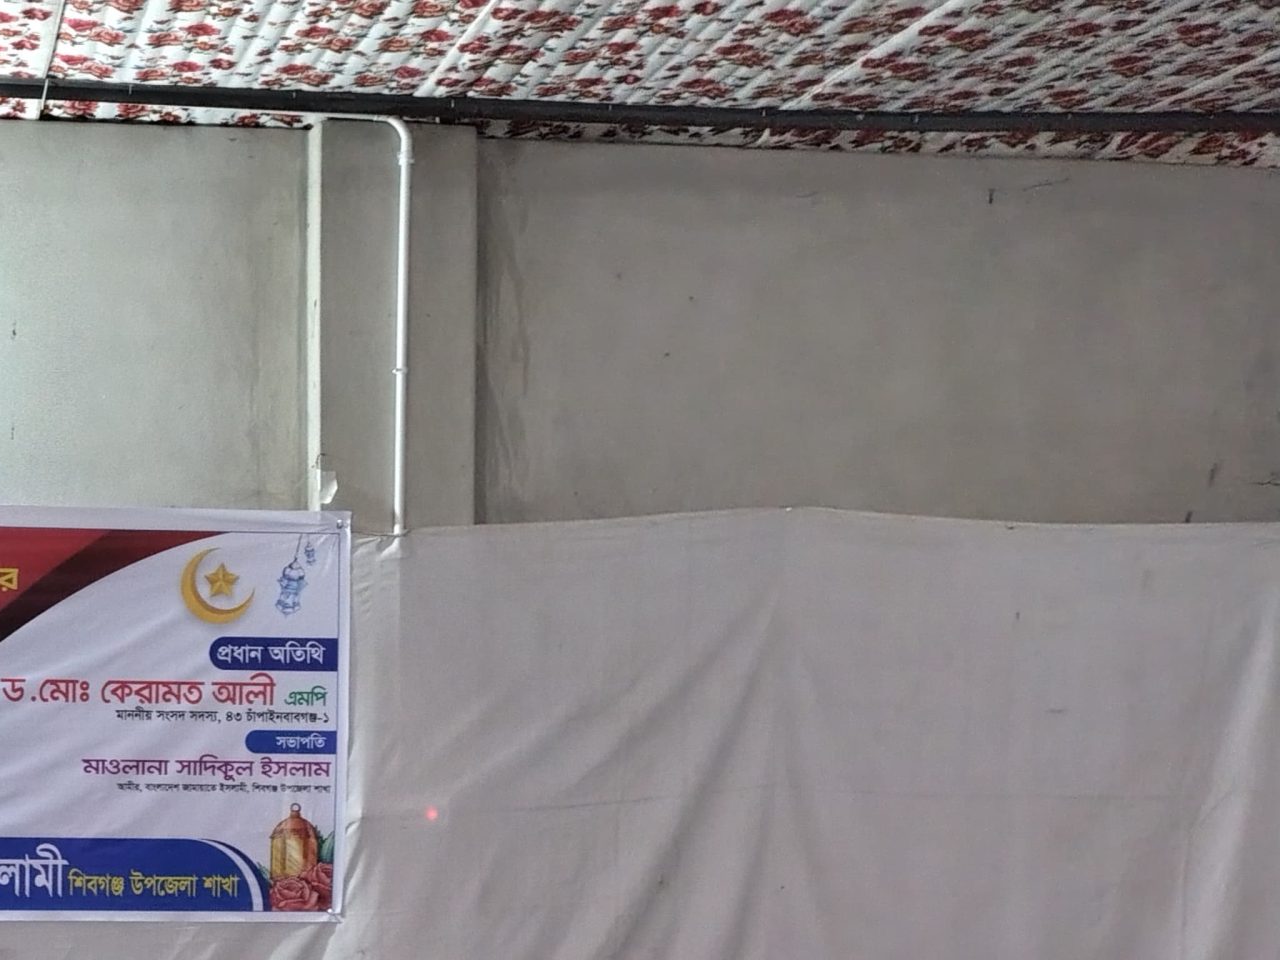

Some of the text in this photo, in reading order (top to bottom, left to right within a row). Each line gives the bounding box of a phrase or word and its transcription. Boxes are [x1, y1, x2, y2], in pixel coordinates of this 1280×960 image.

[217, 641, 326, 665] প্রধান অতিথি
[100, 679, 206, 705] কেরামত
[211, 672, 276, 706] আলী
[284, 686, 327, 706] এমপি
[115, 709, 153, 722] মাননীয়
[156, 710, 186, 722] সংসদ
[225, 711, 242, 722] ৪৩
[276, 735, 327, 750] সভাপতি
[82, 754, 331, 782] মাওলানা সাদিকুল ইসলাম
[68, 869, 124, 897] শিবগঞ্জ
[131, 870, 197, 898] উপজেলা
[203, 875, 241, 898] শাখা
